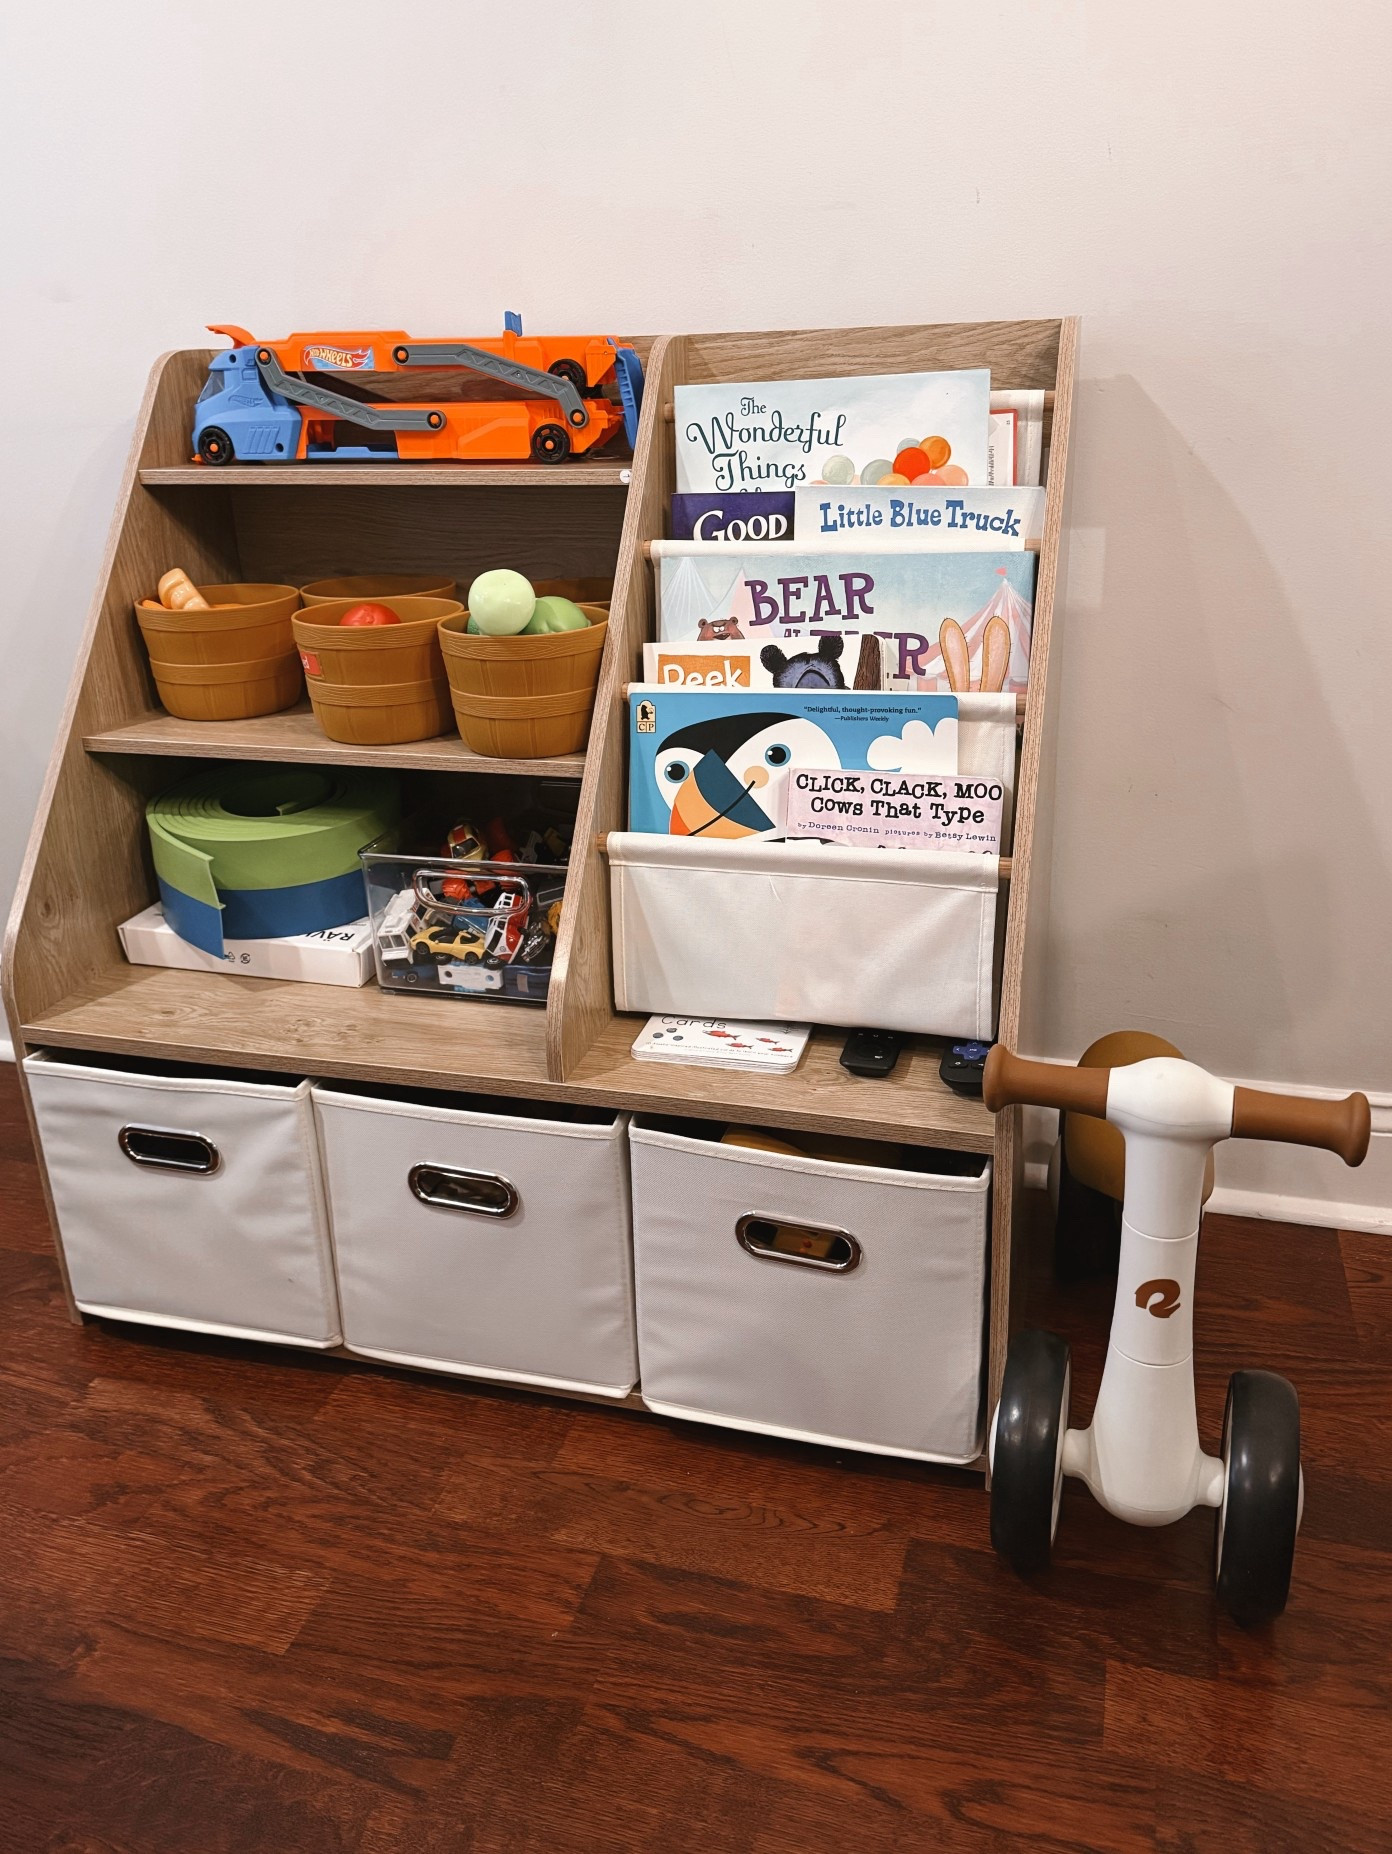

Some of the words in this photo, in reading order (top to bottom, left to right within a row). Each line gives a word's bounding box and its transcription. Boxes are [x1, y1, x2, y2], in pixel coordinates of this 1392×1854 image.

[740, 396, 767, 417] The
[686, 409, 847, 454] Wonderful
[712, 449, 807, 492] Things
[819, 502, 883, 533] Little
[890, 499, 942, 528] Blue
[945, 499, 1021, 537] Truck
[744, 572, 875, 627] BEAR
[663, 659, 744, 687] Peek
[842, 706, 904, 714] thought-provoking
[796, 773, 865, 794] CLICK,
[870, 778, 948, 799] CLACK,
[953, 782, 1003, 801] MOO
[811, 797, 864, 816] Cows
[870, 800, 922, 819] That
[930, 802, 985, 827] Type
[808, 821, 844, 831] Doreen
[846, 824, 880, 834] Cronin
[885, 828, 920, 836] pictures
[934, 831, 963, 841] Betsy
[965, 833, 996, 842] Lewin
[661, 1016, 728, 1029] Cards
